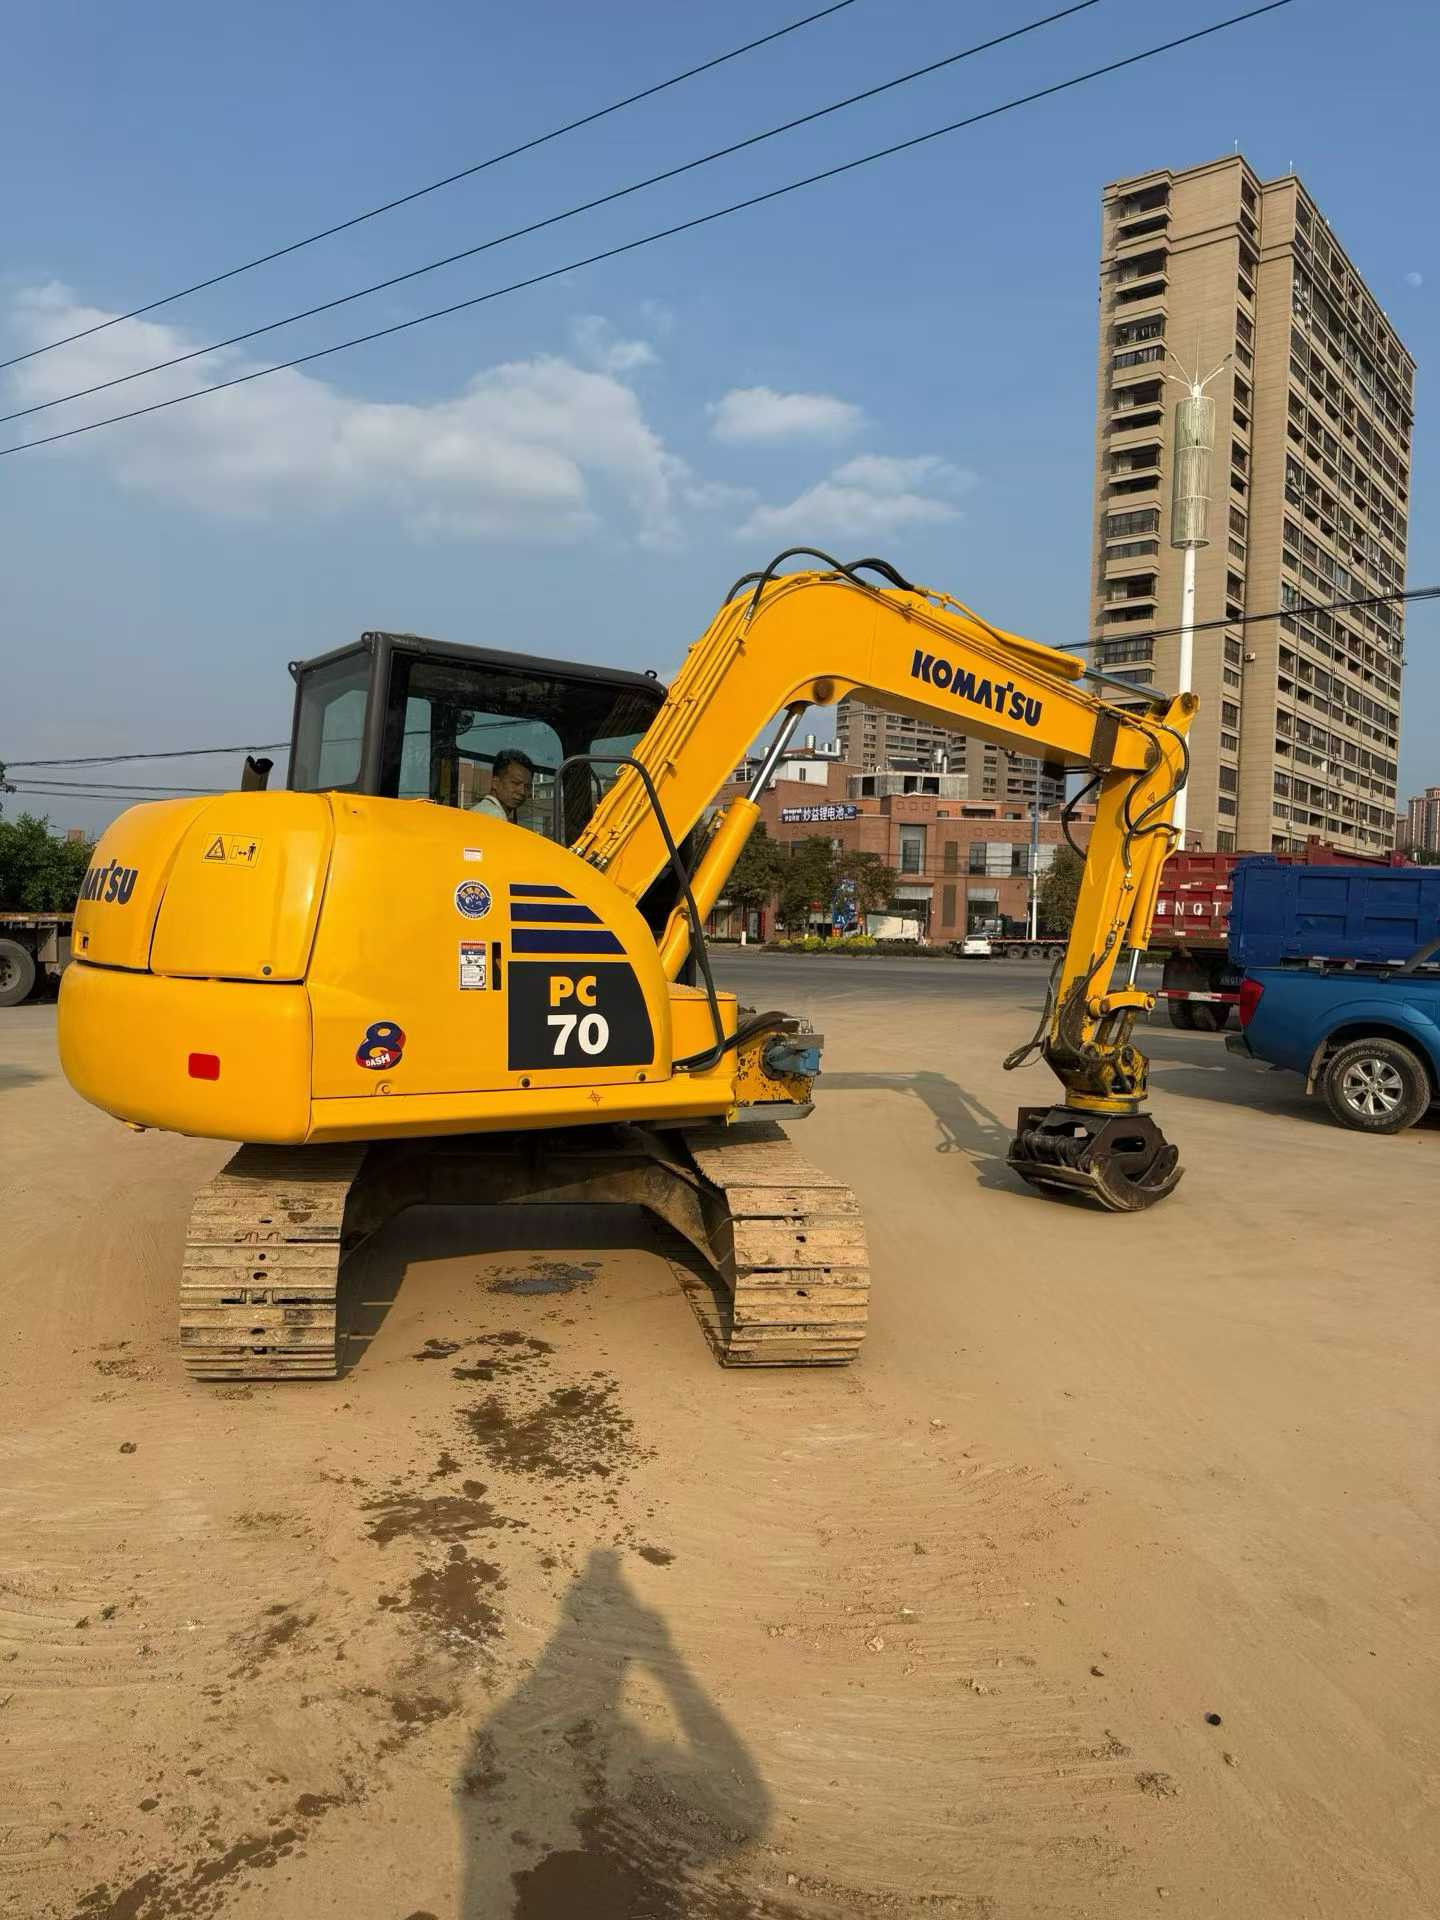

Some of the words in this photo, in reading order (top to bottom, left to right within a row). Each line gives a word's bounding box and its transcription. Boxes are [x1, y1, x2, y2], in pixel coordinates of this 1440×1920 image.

[911, 649, 1043, 727] KOMATSU
[550, 975, 597, 1007] PC
[356, 1021, 406, 1070] 8
[547, 1013, 610, 1056] 70
[365, 1053, 391, 1067] DASH
